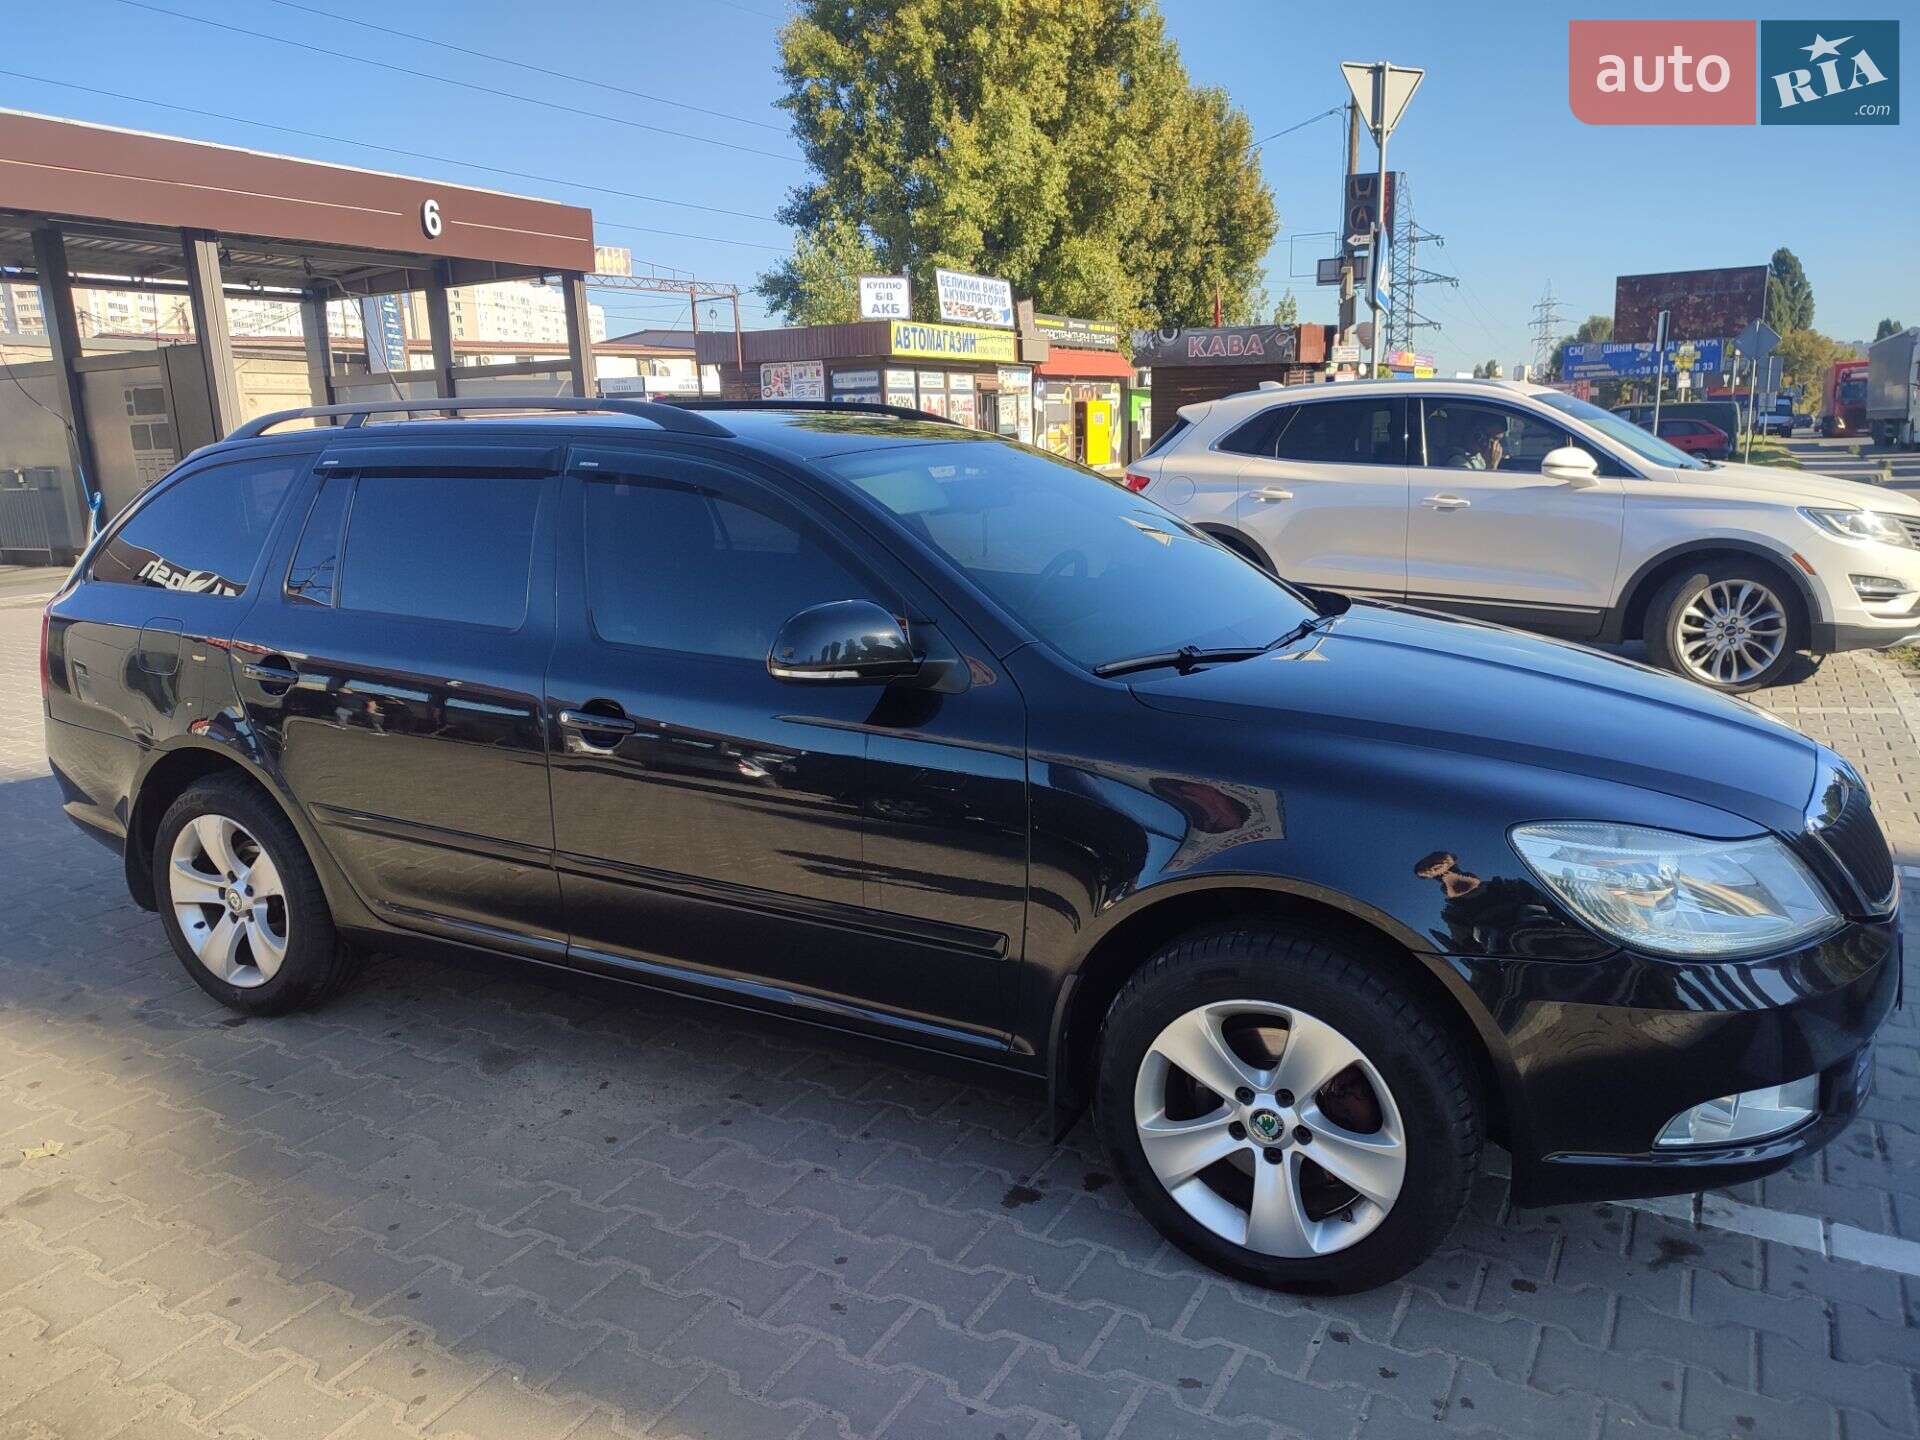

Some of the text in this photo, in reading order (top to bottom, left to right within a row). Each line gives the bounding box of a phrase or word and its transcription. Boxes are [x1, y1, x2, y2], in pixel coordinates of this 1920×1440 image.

[422, 199, 442, 238] 6
[871, 303, 900, 314] АКБ
[895, 325, 977, 354] АВТОМАГАЗИН
[1188, 334, 1264, 357] КАВА
